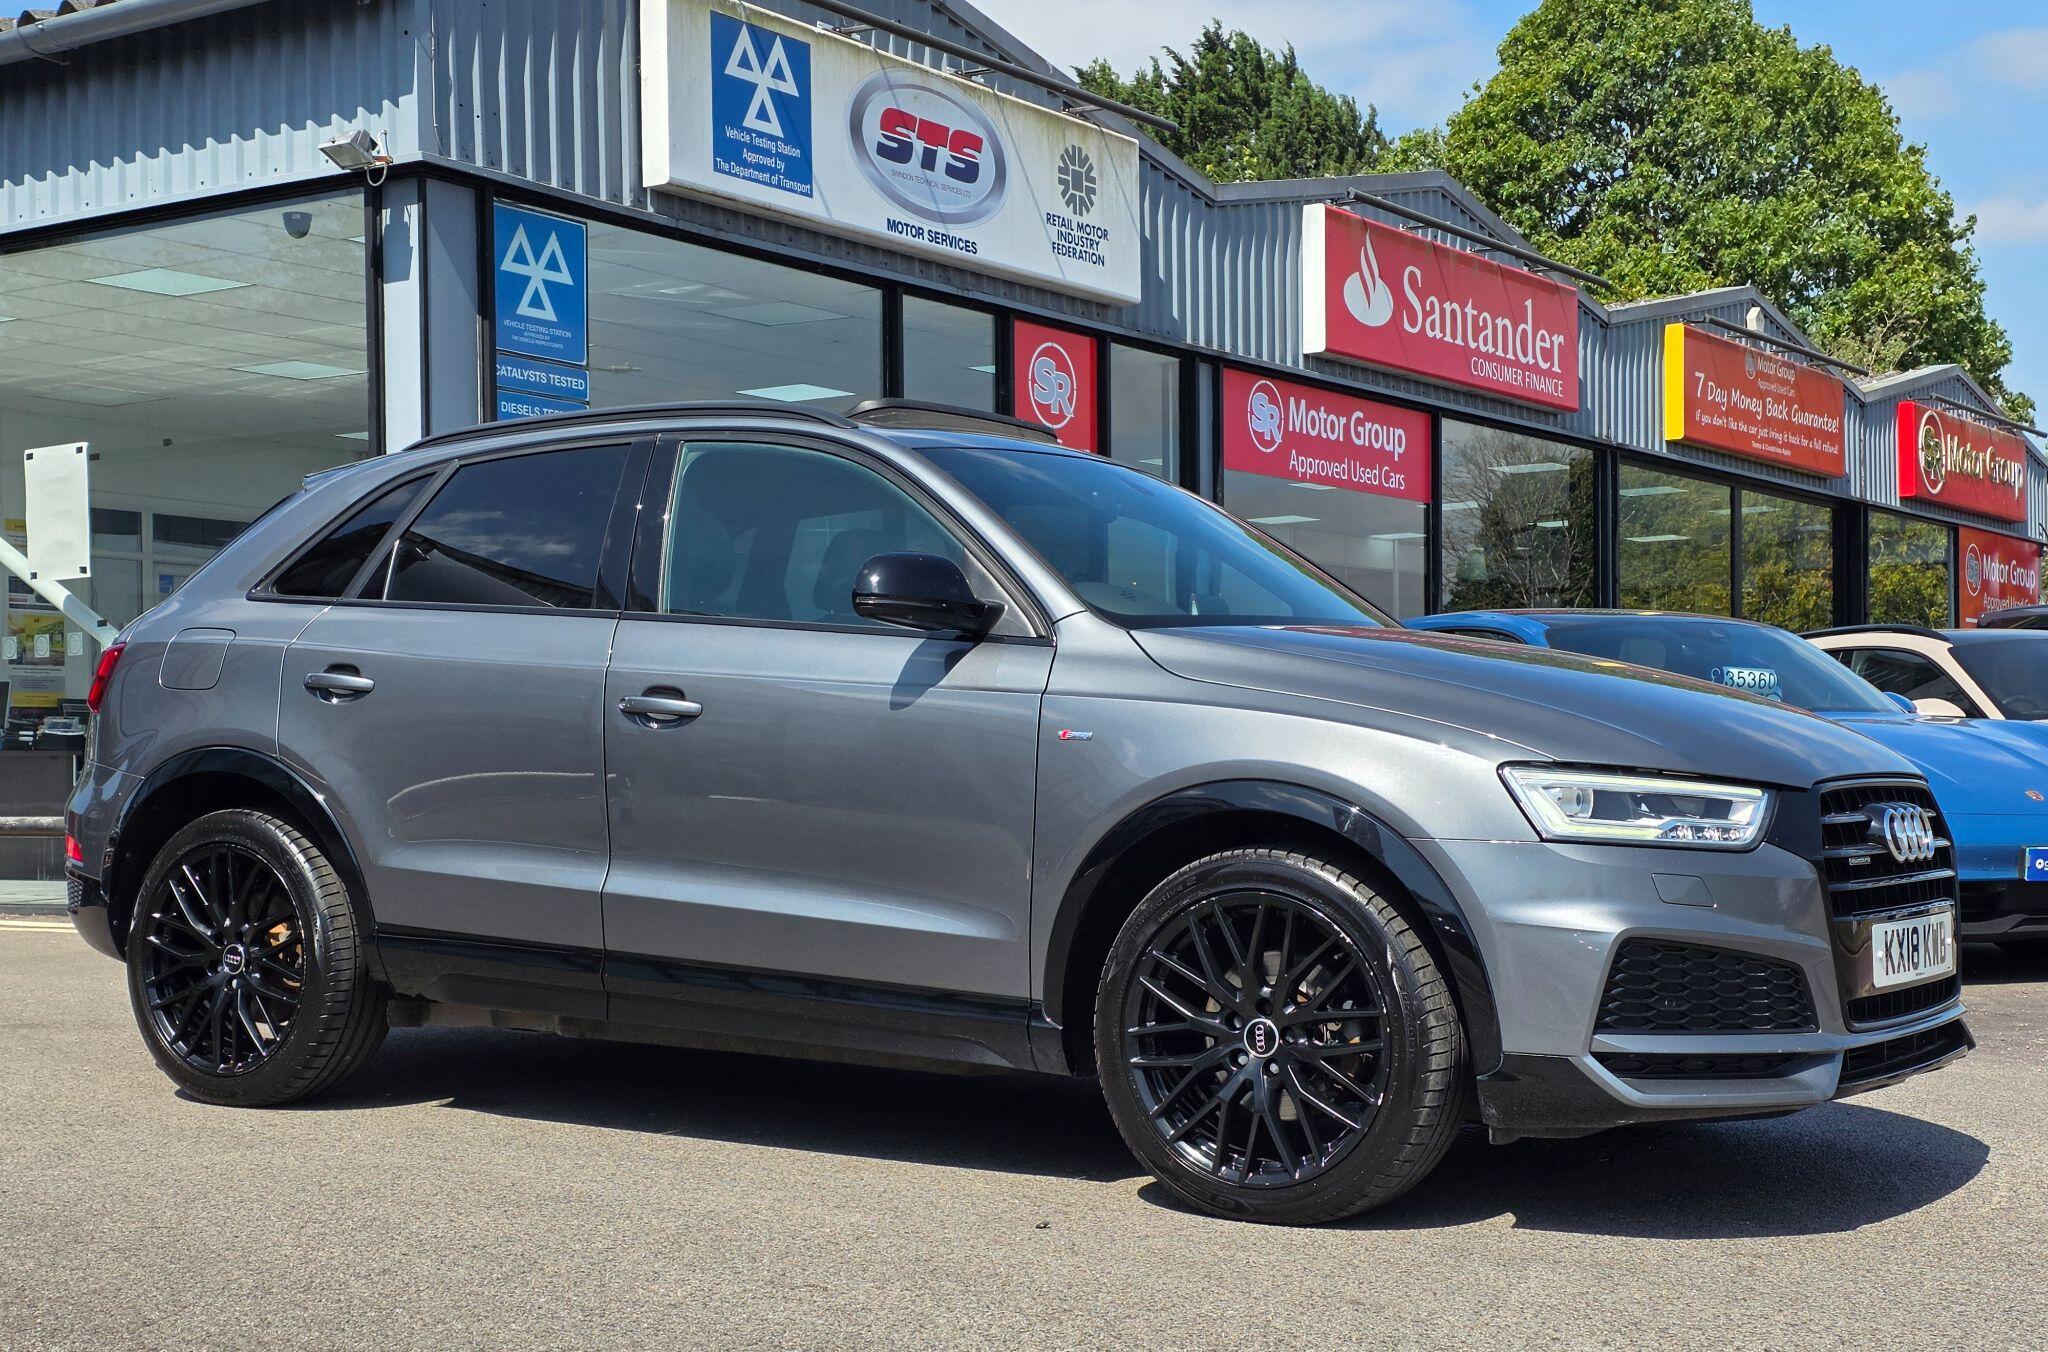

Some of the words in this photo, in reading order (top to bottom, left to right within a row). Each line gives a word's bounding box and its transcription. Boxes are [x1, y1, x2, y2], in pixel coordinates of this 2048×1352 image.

[725, 124, 751, 143] Vehicle
[751, 133, 776, 153] Testing
[777, 141, 801, 158] Station
[876, 107, 984, 184] STS
[715, 157, 729, 171] The
[730, 161, 770, 183] Department
[771, 174, 778, 186] of
[779, 175, 811, 194] Transport
[742, 147, 775, 168] Approved
[776, 157, 785, 173] by
[886, 217, 925, 240] MOTOR
[927, 229, 978, 255] SERVICES
[1046, 212, 1074, 231] RETAIL
[1076, 221, 1109, 242] MOTOR
[1057, 229, 1100, 252] INDUSTRY
[1052, 241, 1105, 267] FEDERATION
[503, 319, 526, 330] VEHICLE
[526, 323, 549, 334] TESTING
[549, 328, 572, 338] STATION
[1403, 265, 1565, 373] Santander
[549, 374, 585, 390] TESTED
[1034, 356, 1075, 417] SR
[1471, 357, 1523, 387] CONSUMER
[1525, 371, 1564, 398] FINANCE
[1757, 355, 1776, 375] Motor
[1776, 361, 1796, 385] Group
[501, 401, 541, 417] DIESELS
[1695, 371, 1705, 398] 7
[1707, 381, 1728, 411] Day
[1731, 387, 1762, 420] Money
[1766, 397, 1789, 421] Back
[1791, 404, 1840, 433] Guarantee!
[1251, 392, 1283, 443] SR
[1288, 396, 1347, 442] Motor
[1350, 410, 1406, 462] Group
[1289, 449, 1348, 480] Approved
[1351, 460, 1379, 486] Used
[1381, 466, 1405, 490] Cars
[1946, 433, 1985, 480] Motor
[1986, 446, 2023, 500] Group
[1983, 554, 2009, 584] Motor
[2010, 560, 2036, 595] Group
[1983, 592, 2010, 613] Approved
[1884, 926, 1920, 976] KX18
